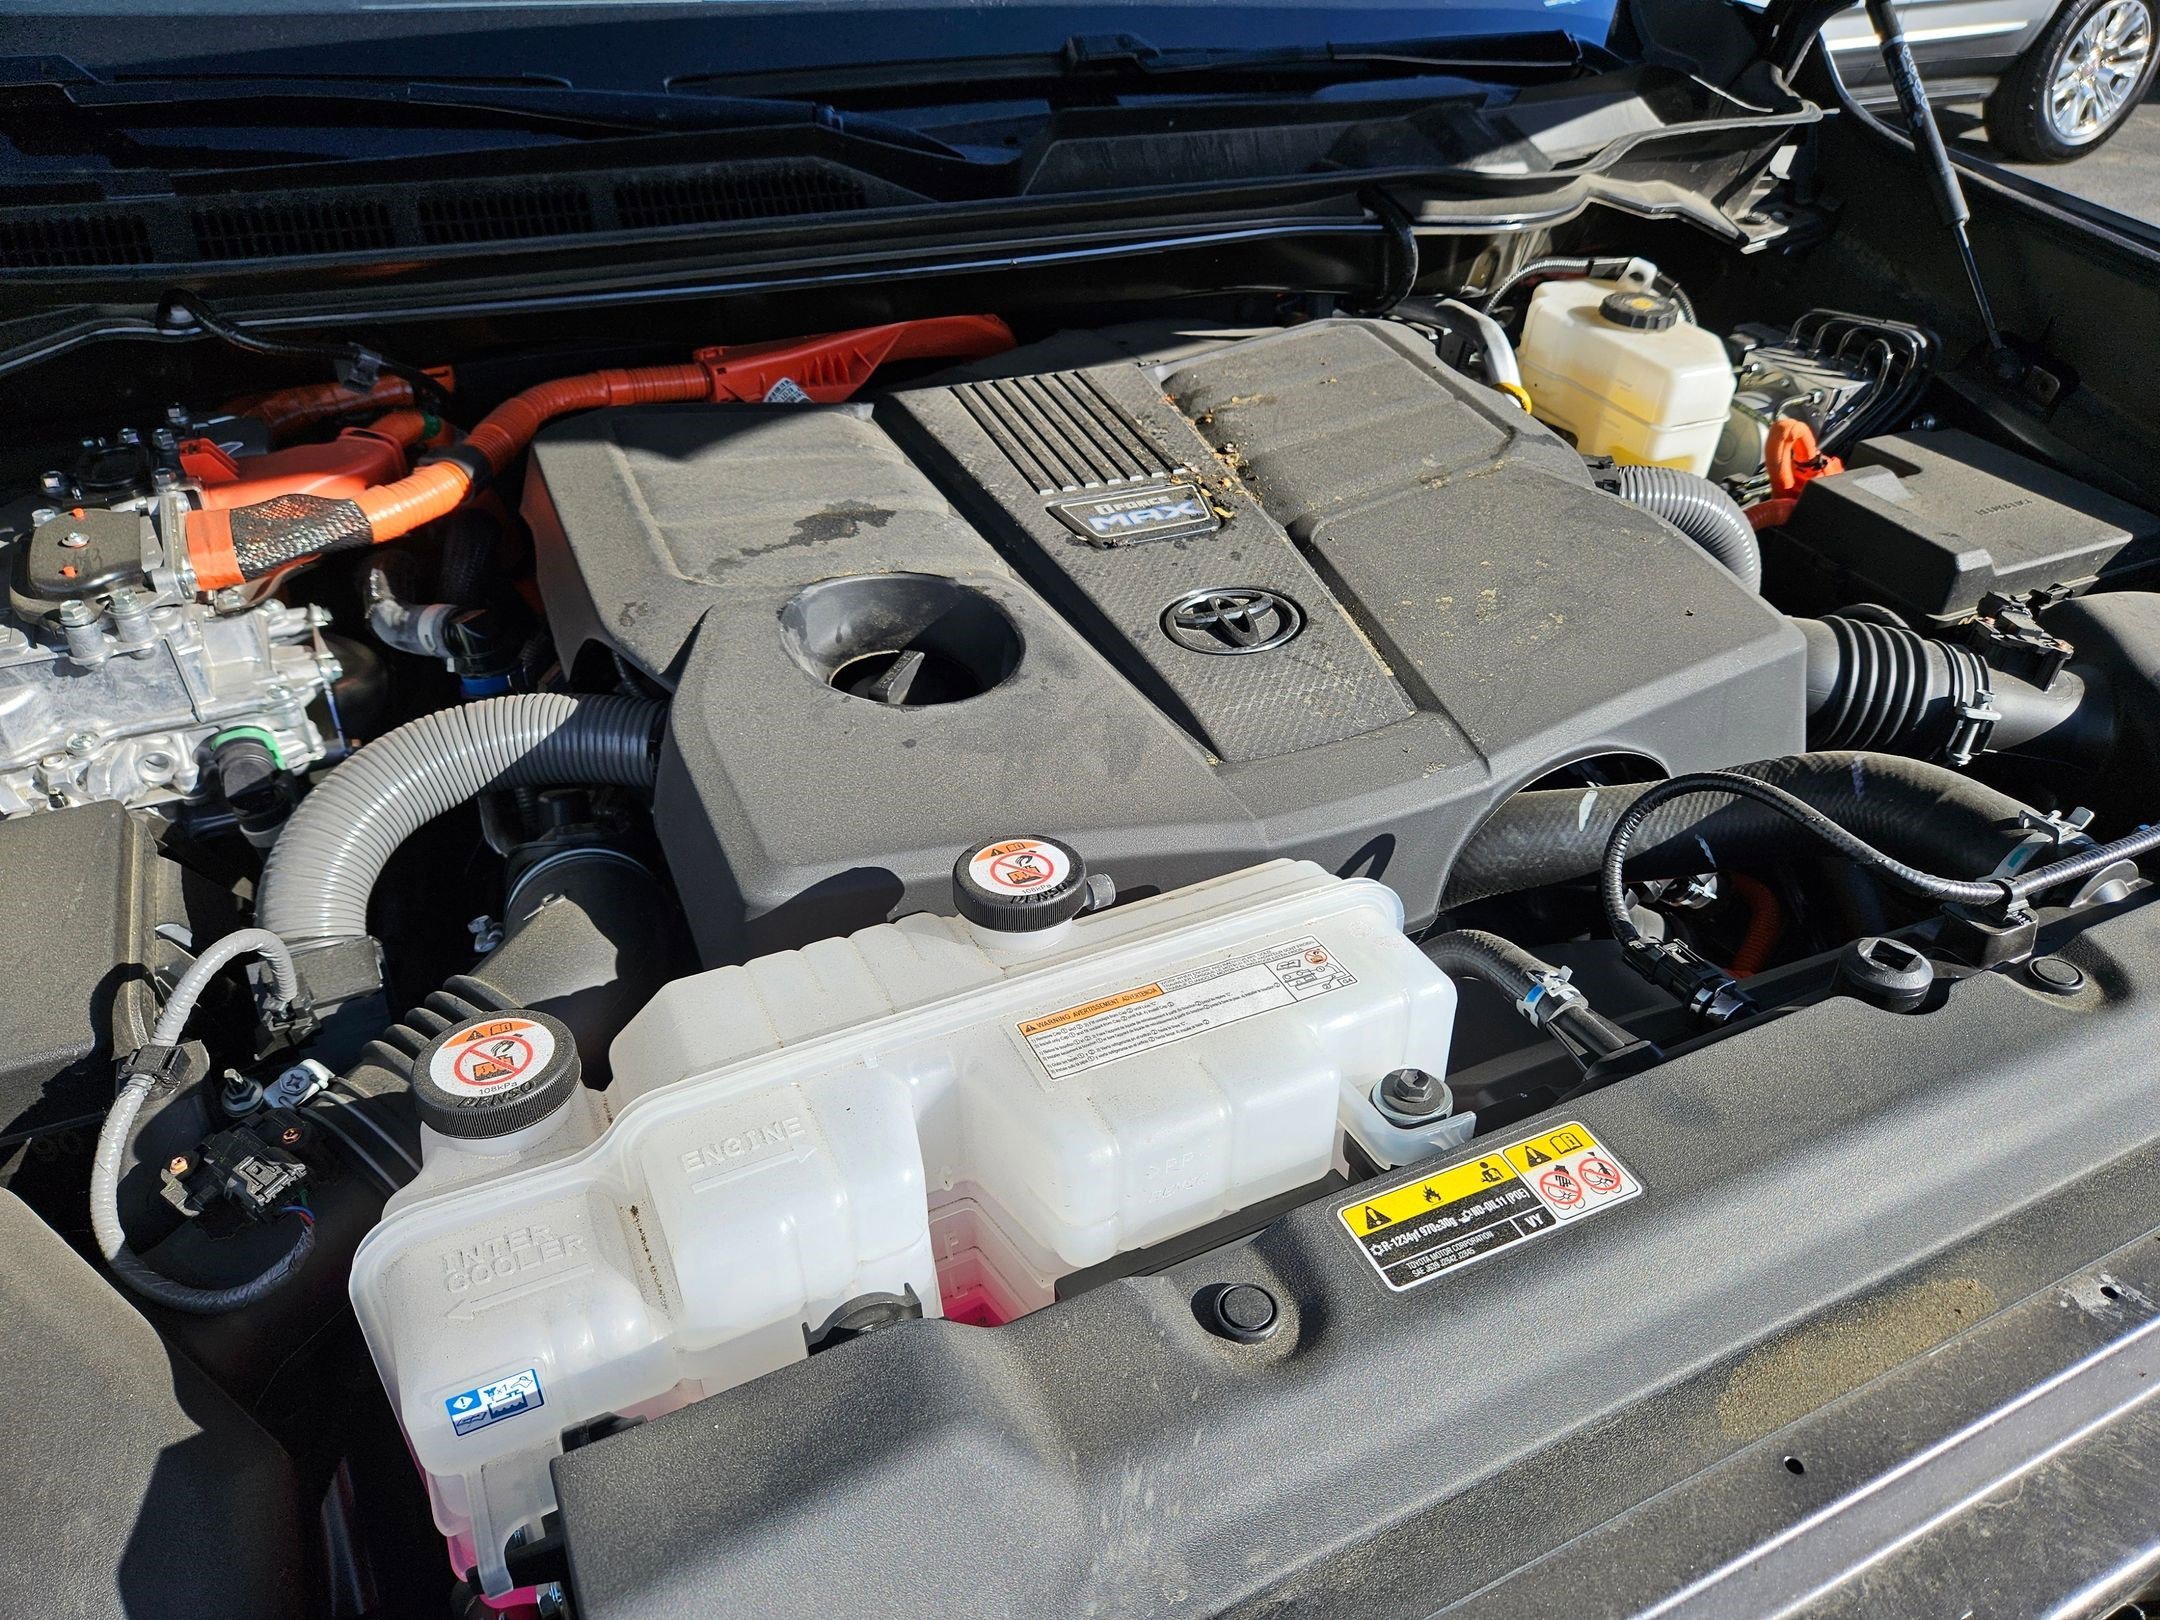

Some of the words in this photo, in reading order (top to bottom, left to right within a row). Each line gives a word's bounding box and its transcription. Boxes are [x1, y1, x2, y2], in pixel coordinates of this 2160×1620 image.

[1088, 499, 1204, 532] MAX
[1036, 1013, 1071, 1028] WARNING
[1072, 998, 1119, 1017] AVERTISSEMENT
[1122, 987, 1158, 1002] ADVERTENCIA
[457, 1082, 536, 1108] DENSO
[479, 1081, 517, 1095] 108kPa
[681, 1117, 806, 1173] ENGINE
[1382, 1231, 1421, 1252] R-1234yf
[1419, 1216, 1456, 1239] 970±30g
[1507, 1188, 1530, 1205] (POE)
[1524, 1213, 1544, 1228] VY
[441, 1224, 553, 1274] INTER
[445, 1235, 588, 1293] COOLER
[1406, 1255, 1431, 1270] TOYOTA
[1429, 1246, 1453, 1261] MOTOR
[1452, 1231, 1494, 1252] CORPORATION
[1411, 1266, 1425, 1278] SAE
